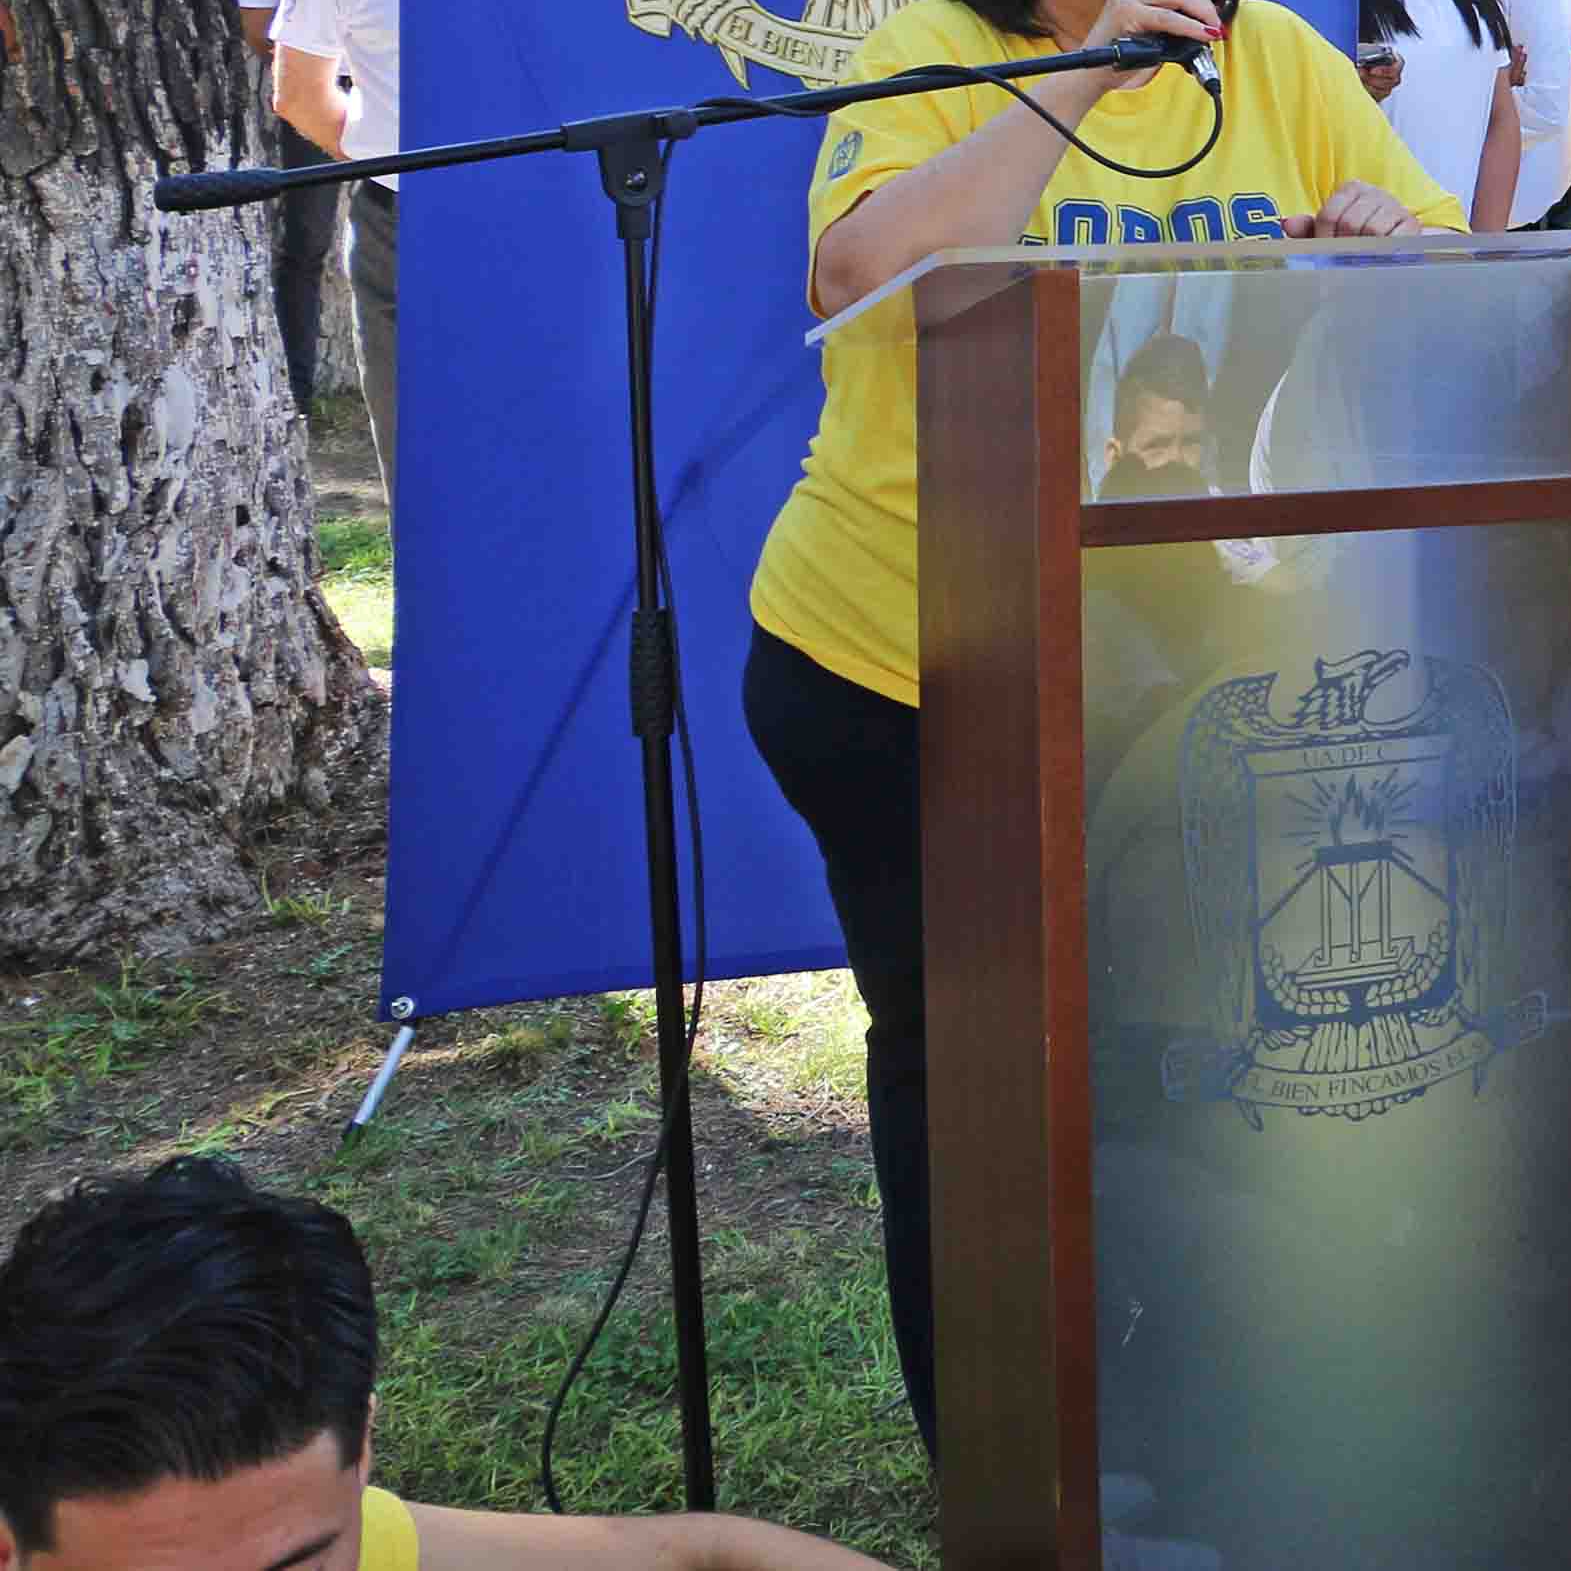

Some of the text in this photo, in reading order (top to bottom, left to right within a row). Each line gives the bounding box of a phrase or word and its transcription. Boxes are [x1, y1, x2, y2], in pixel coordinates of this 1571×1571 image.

[727, 14, 755, 47] EL
[763, 29, 828, 71] BIEN
[1018, 192, 1287, 246] OBOS
[1270, 1079, 1320, 1102] BIEN
[1328, 1062, 1442, 1097] FINCAMOS
